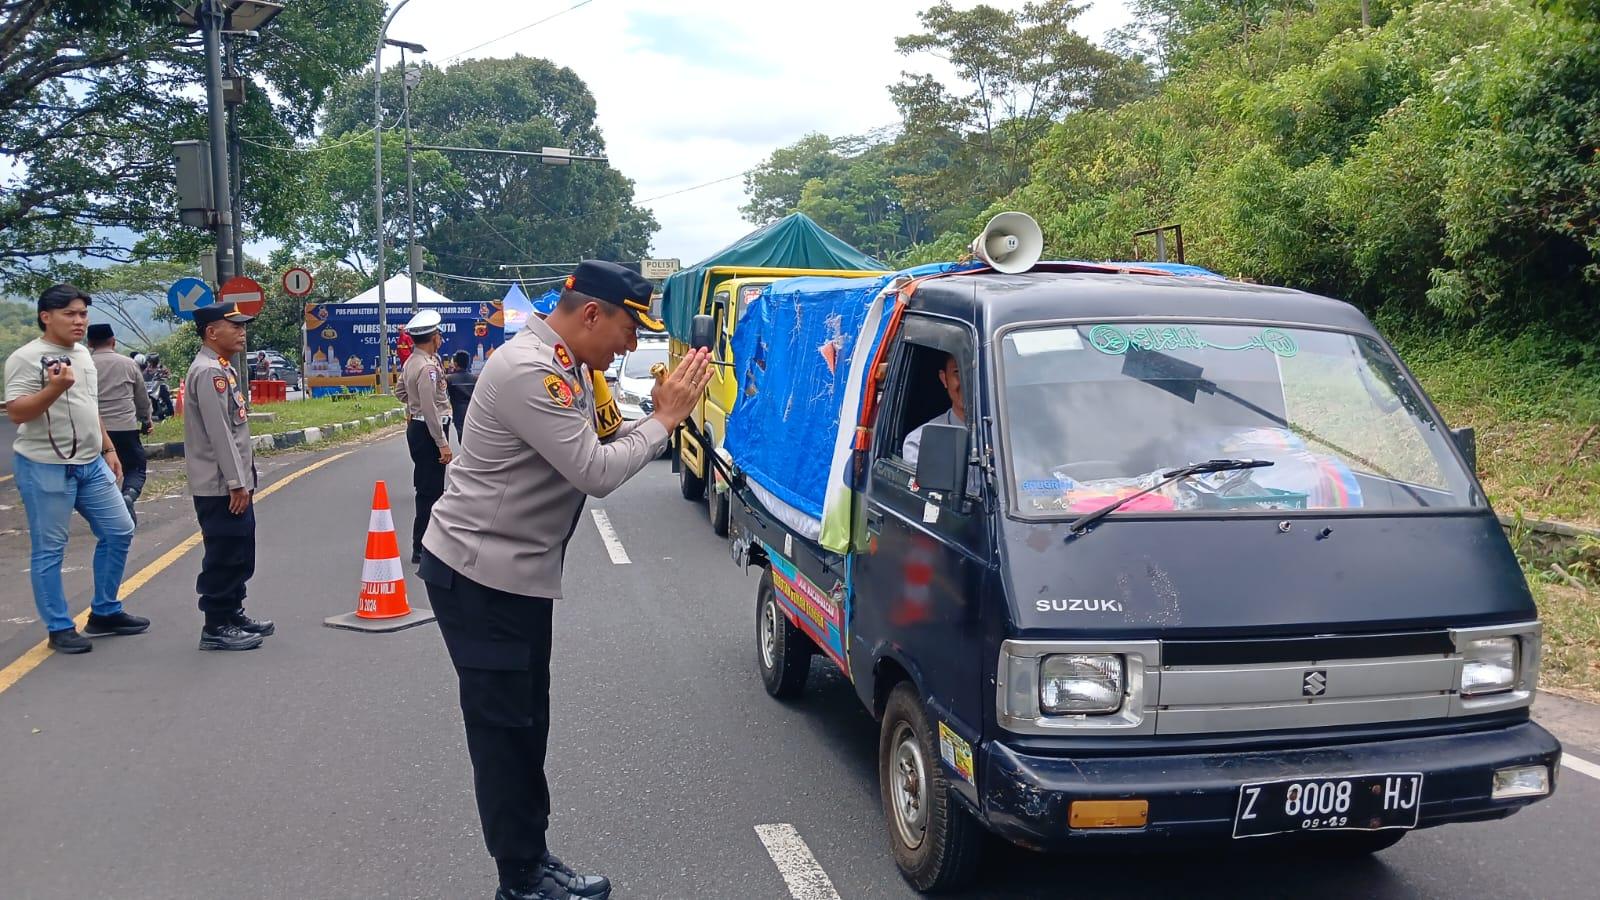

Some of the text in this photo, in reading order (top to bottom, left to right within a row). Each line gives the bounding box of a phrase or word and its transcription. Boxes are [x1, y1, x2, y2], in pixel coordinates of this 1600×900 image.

[352, 324, 381, 334] POLRES
[597, 404, 621, 430] KA
[1036, 599, 1123, 612] SUZUKI
[1242, 777, 1418, 820] Z 8008 HJ
